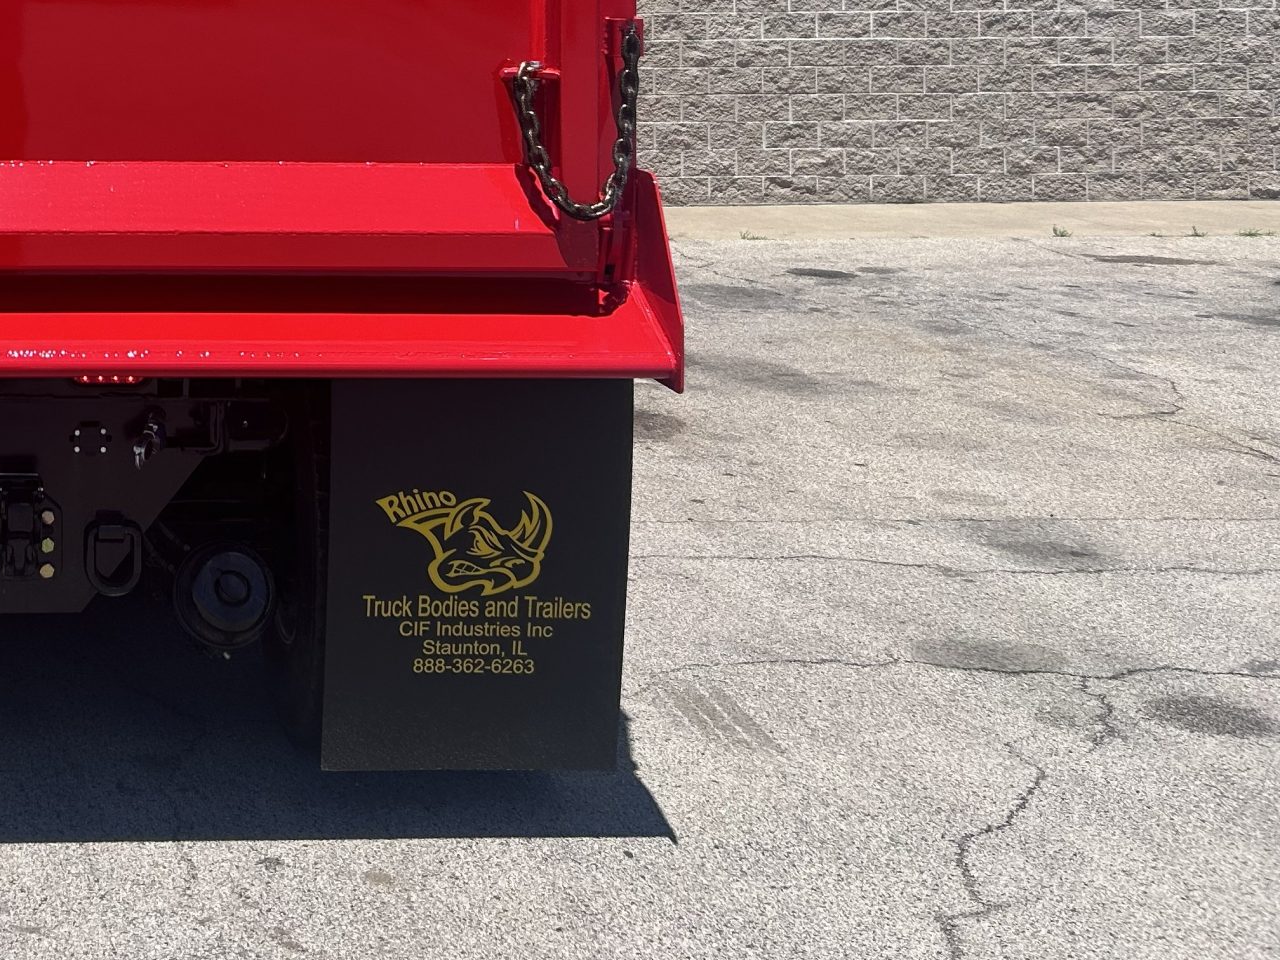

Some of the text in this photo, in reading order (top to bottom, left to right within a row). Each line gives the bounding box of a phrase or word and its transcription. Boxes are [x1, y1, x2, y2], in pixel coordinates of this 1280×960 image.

[375, 488, 457, 524] Rhino
[362, 594, 592, 620] Truck Bodies and Trailers
[399, 621, 554, 638] CIF Industries Inc
[422, 639, 528, 658] Staunton, IL
[413, 657, 535, 675] 888-362-6263
